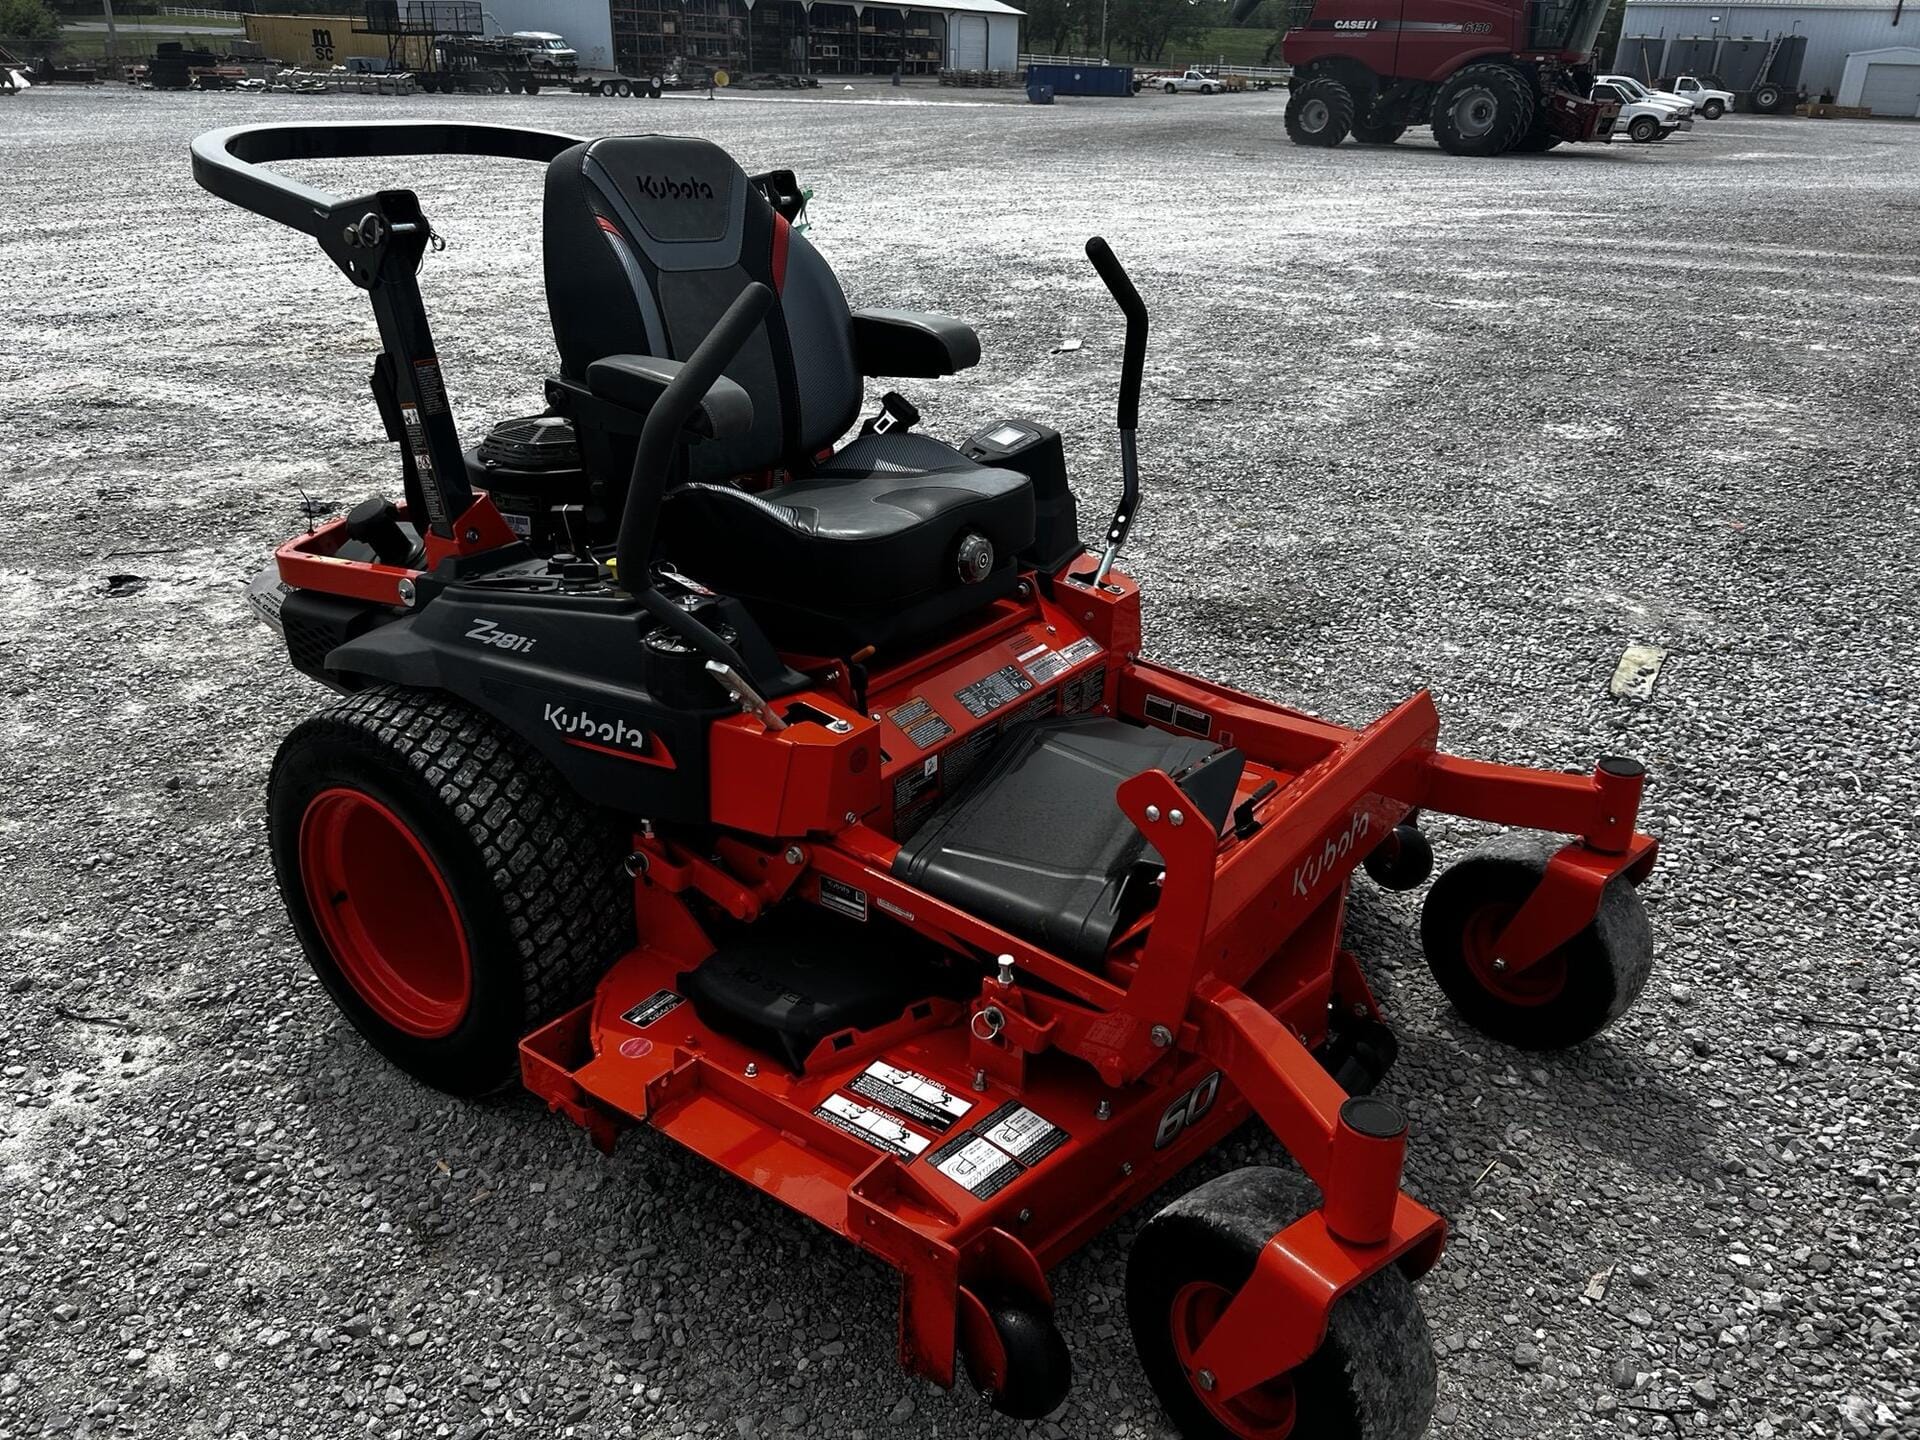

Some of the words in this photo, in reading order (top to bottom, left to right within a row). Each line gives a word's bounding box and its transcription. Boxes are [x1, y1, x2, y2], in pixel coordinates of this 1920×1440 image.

[1334, 19, 1366, 30] CASE
[636, 174, 714, 199] Kubota
[464, 618, 537, 653] Z781i
[543, 703, 644, 748] Kubota
[1292, 811, 1369, 897] Kubota
[913, 1070, 947, 1091] PELIGRO
[872, 1106, 906, 1127] DANGER
[1153, 1071, 1219, 1151] 60
